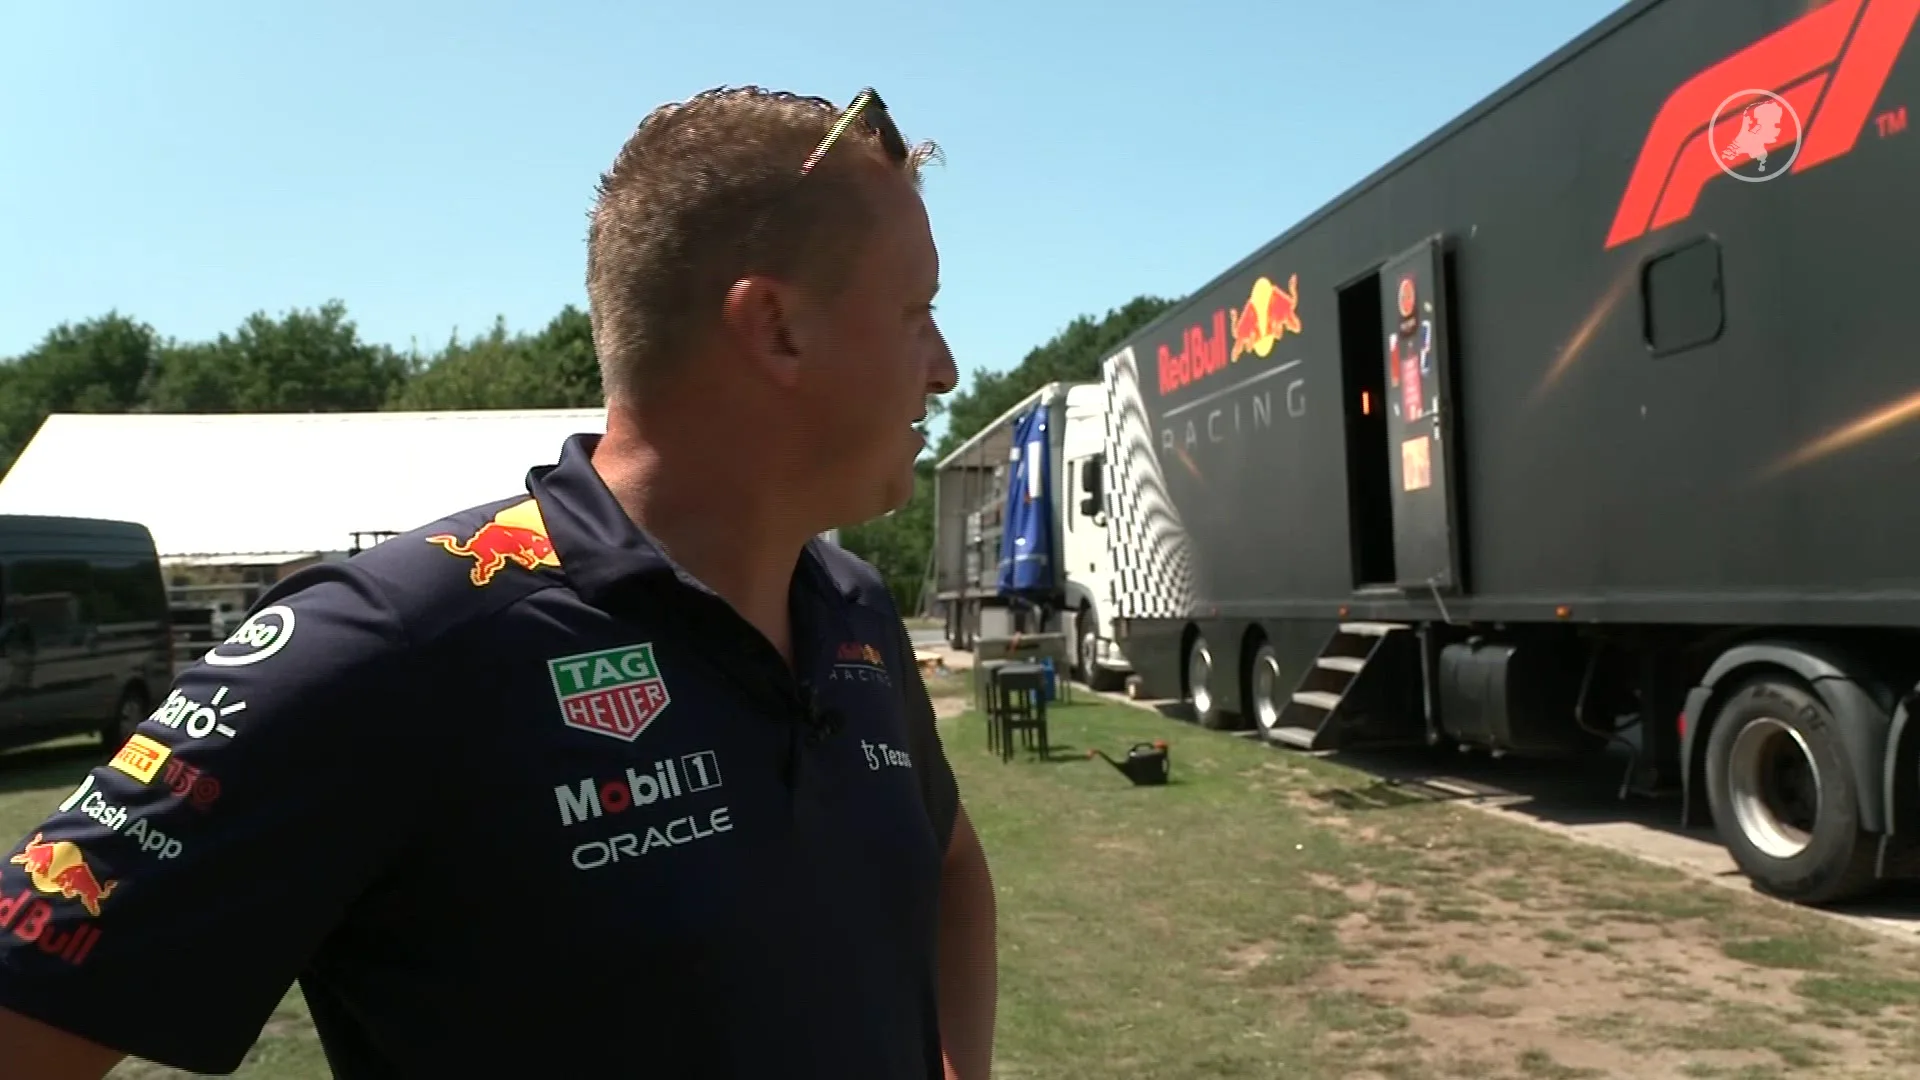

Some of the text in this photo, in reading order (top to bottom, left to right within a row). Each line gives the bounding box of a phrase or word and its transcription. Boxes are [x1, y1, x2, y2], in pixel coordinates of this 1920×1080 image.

[1875, 108, 1908, 138] TM
[1158, 310, 1227, 396] Red Bull
[1160, 379, 1305, 451] RACING
[224, 624, 279, 647] sso
[559, 650, 651, 691] TAG
[567, 682, 663, 734] HEUER
[554, 758, 682, 827] Mobil
[81, 791, 183, 861] Cash App
[572, 807, 734, 871] ORACLE
[14, 900, 103, 966] Bull
